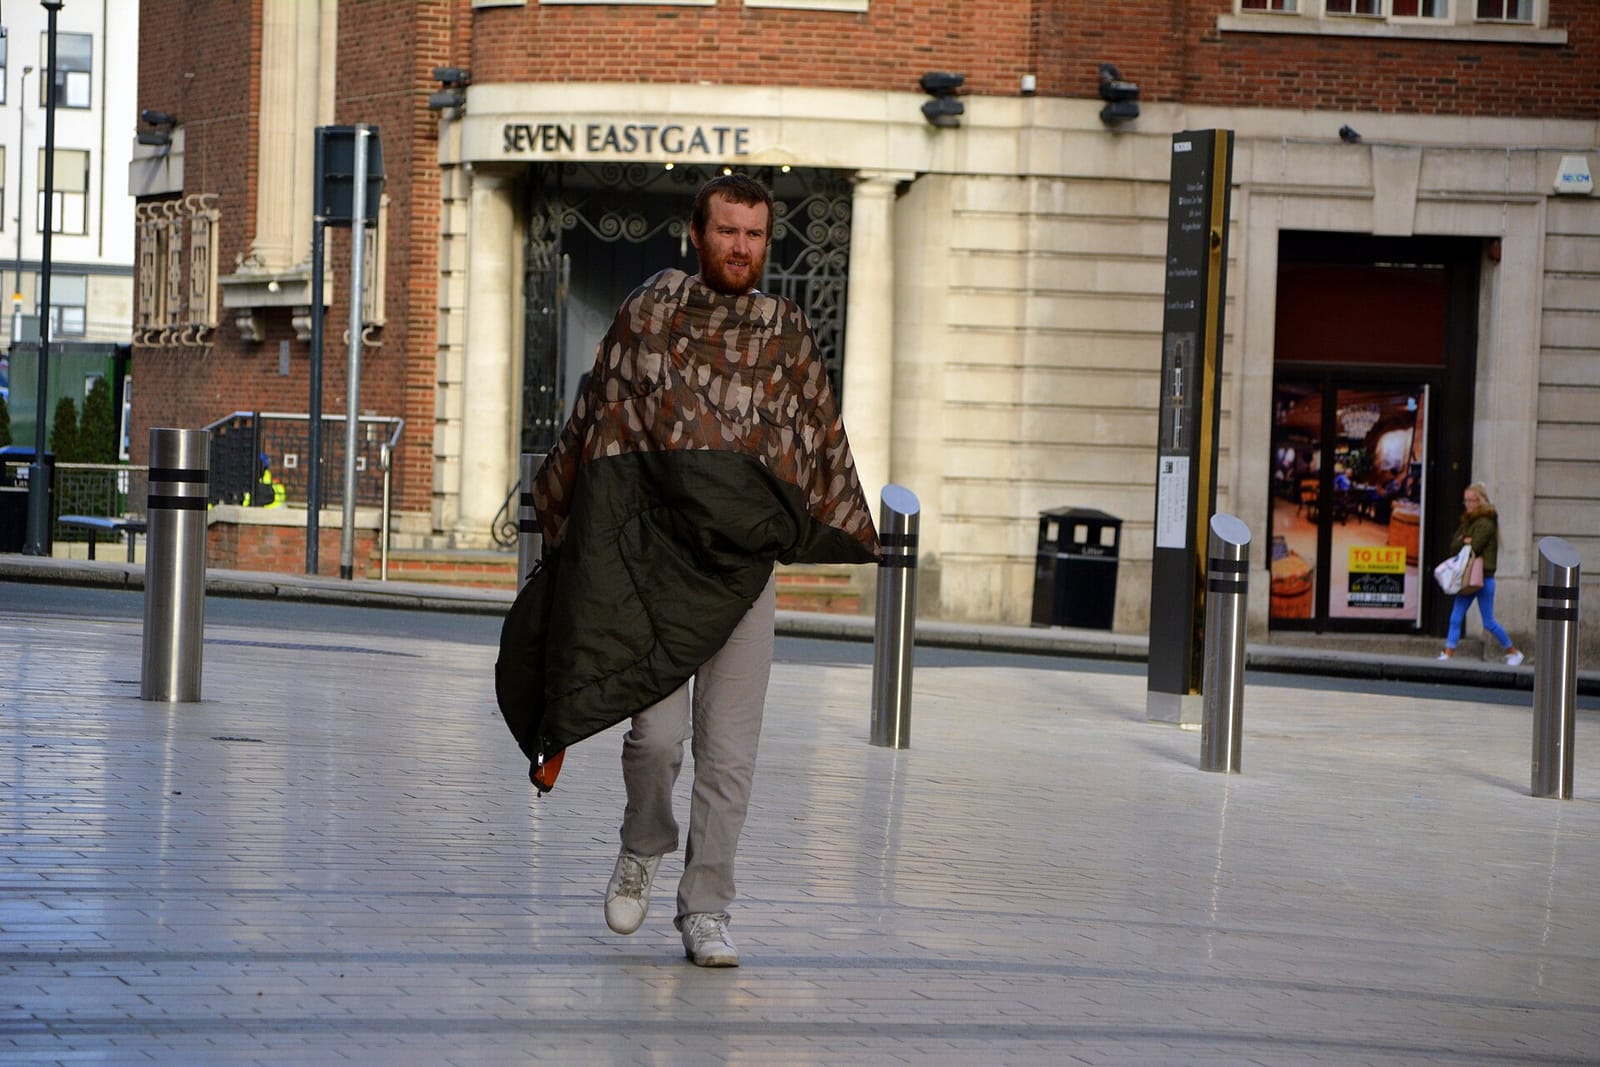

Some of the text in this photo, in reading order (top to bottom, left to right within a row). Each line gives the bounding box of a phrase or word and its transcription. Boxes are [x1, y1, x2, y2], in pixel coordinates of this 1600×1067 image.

[503, 123, 750, 155] SEVEN EASTGATE
[1354, 550, 1402, 563] TO LET
